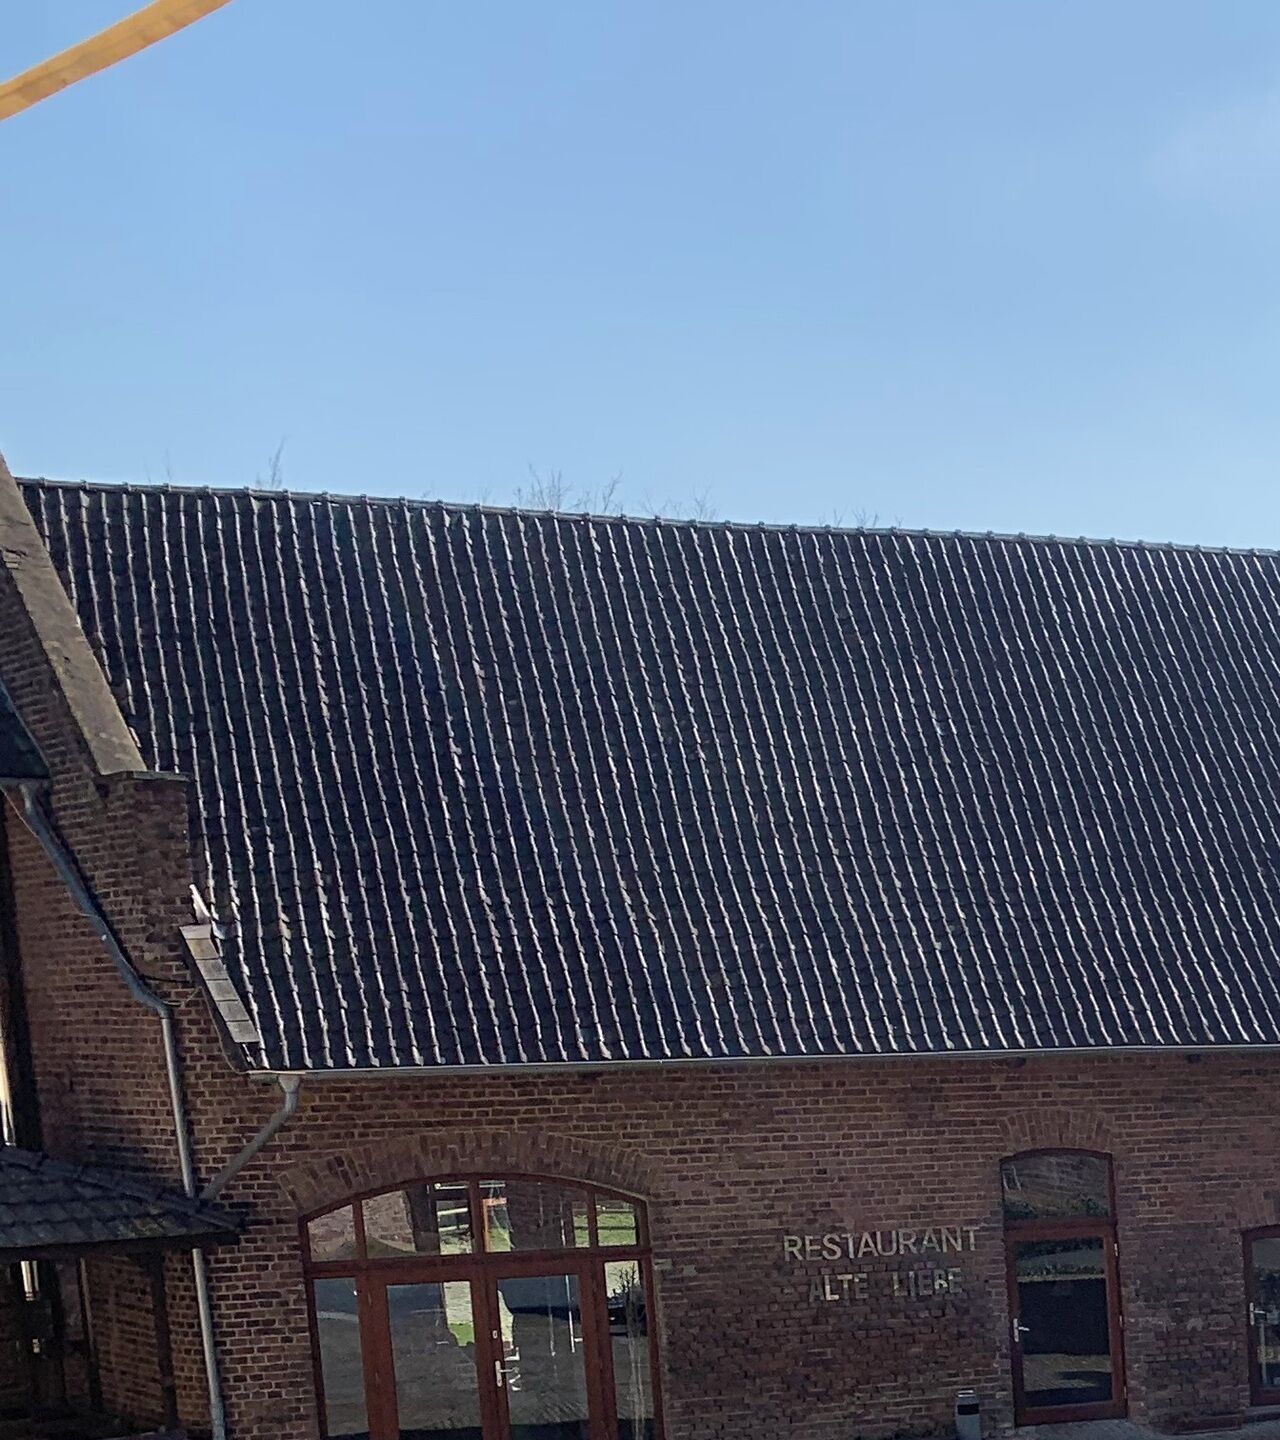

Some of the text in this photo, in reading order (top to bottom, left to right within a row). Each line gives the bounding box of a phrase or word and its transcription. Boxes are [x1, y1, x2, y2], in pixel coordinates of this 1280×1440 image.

[784, 1227, 980, 1262] RESTAURANT
[809, 1268, 963, 1302] ALTE LIEBE
